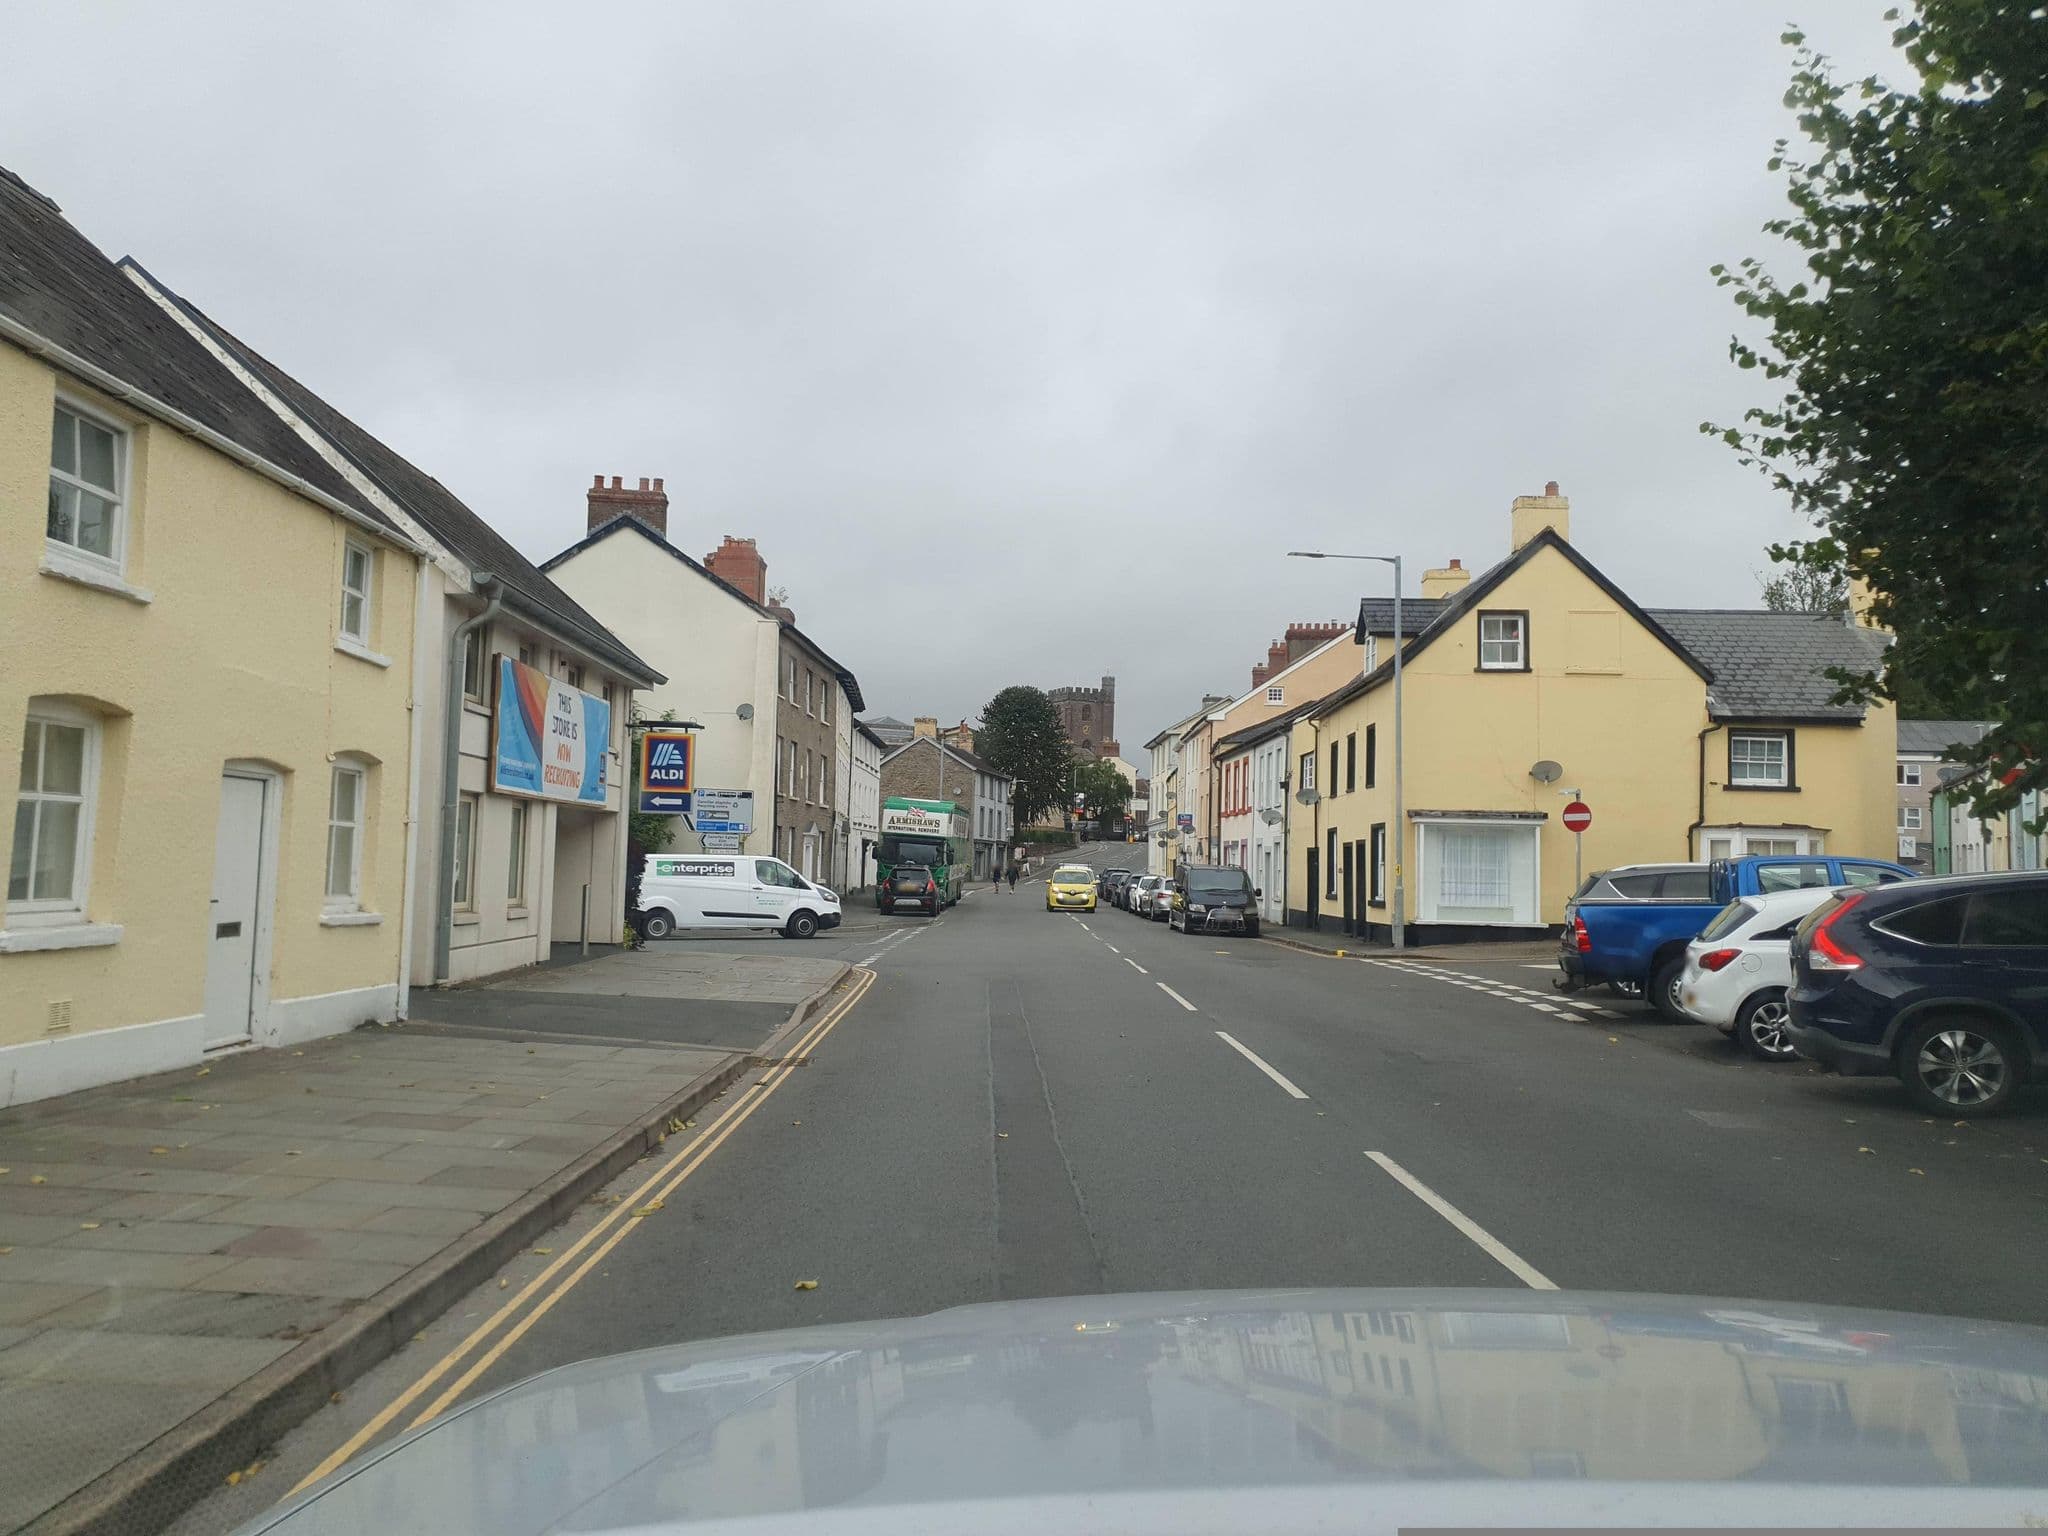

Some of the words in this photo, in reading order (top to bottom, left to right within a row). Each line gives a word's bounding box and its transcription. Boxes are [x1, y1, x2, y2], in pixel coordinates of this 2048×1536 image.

[558, 692, 572, 714] THIS
[552, 715, 571, 739] STORE
[571, 722, 578, 740] IS
[556, 742, 572, 762] NOW
[543, 764, 581, 789] RECRUITING
[650, 769, 684, 780] ALDI
[888, 816, 941, 828] ARMISHAWS
[661, 864, 734, 875] enterprise
